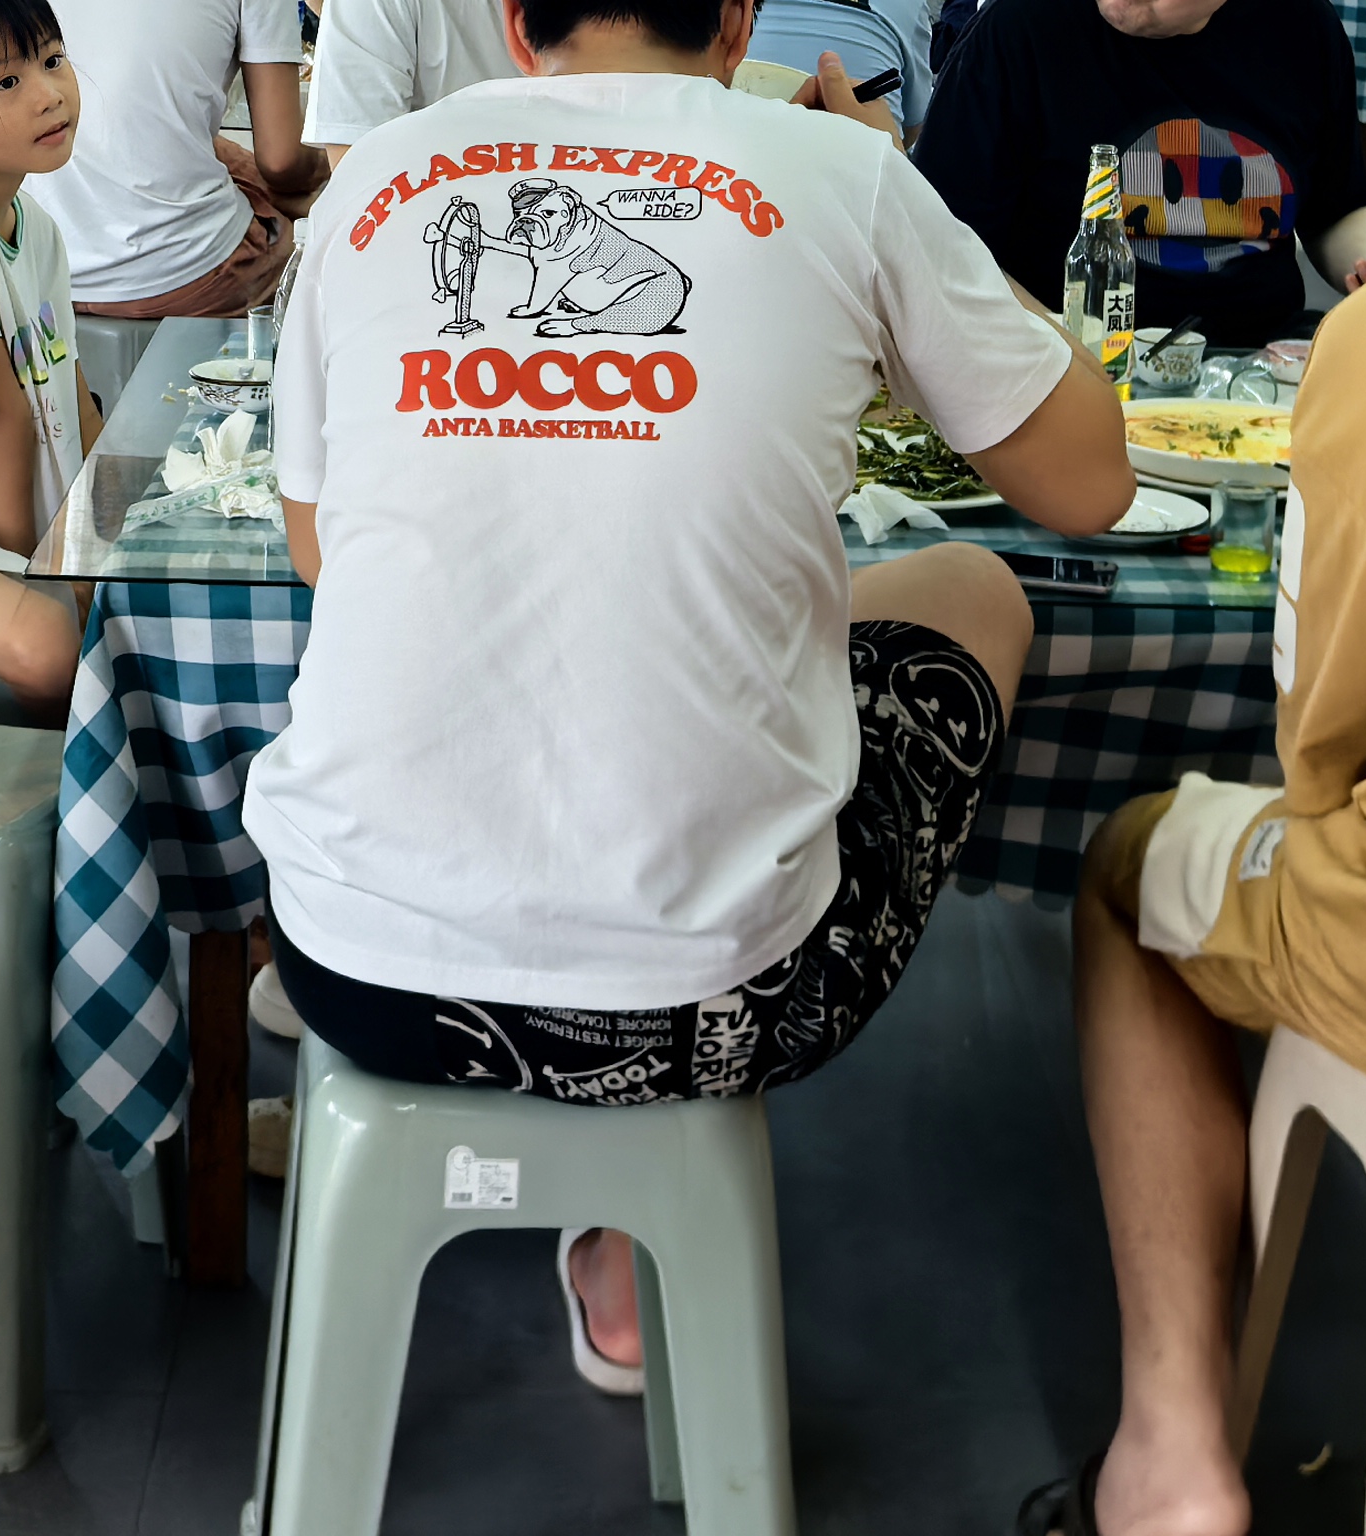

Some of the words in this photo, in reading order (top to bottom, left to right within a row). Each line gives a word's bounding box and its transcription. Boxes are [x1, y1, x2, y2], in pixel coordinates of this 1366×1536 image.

[349, 142, 540, 252] SPLASH
[548, 145, 785, 238] EXPRESS
[616, 189, 676, 203] WANNA
[642, 203, 694, 219] RIDE?
[395, 347, 698, 414] ROCCO
[422, 417, 494, 438] ANTA
[498, 417, 661, 441] BASKETBALL
[614, 1034, 673, 1048] FORGET
[548, 1053, 673, 1099] TODAY!
